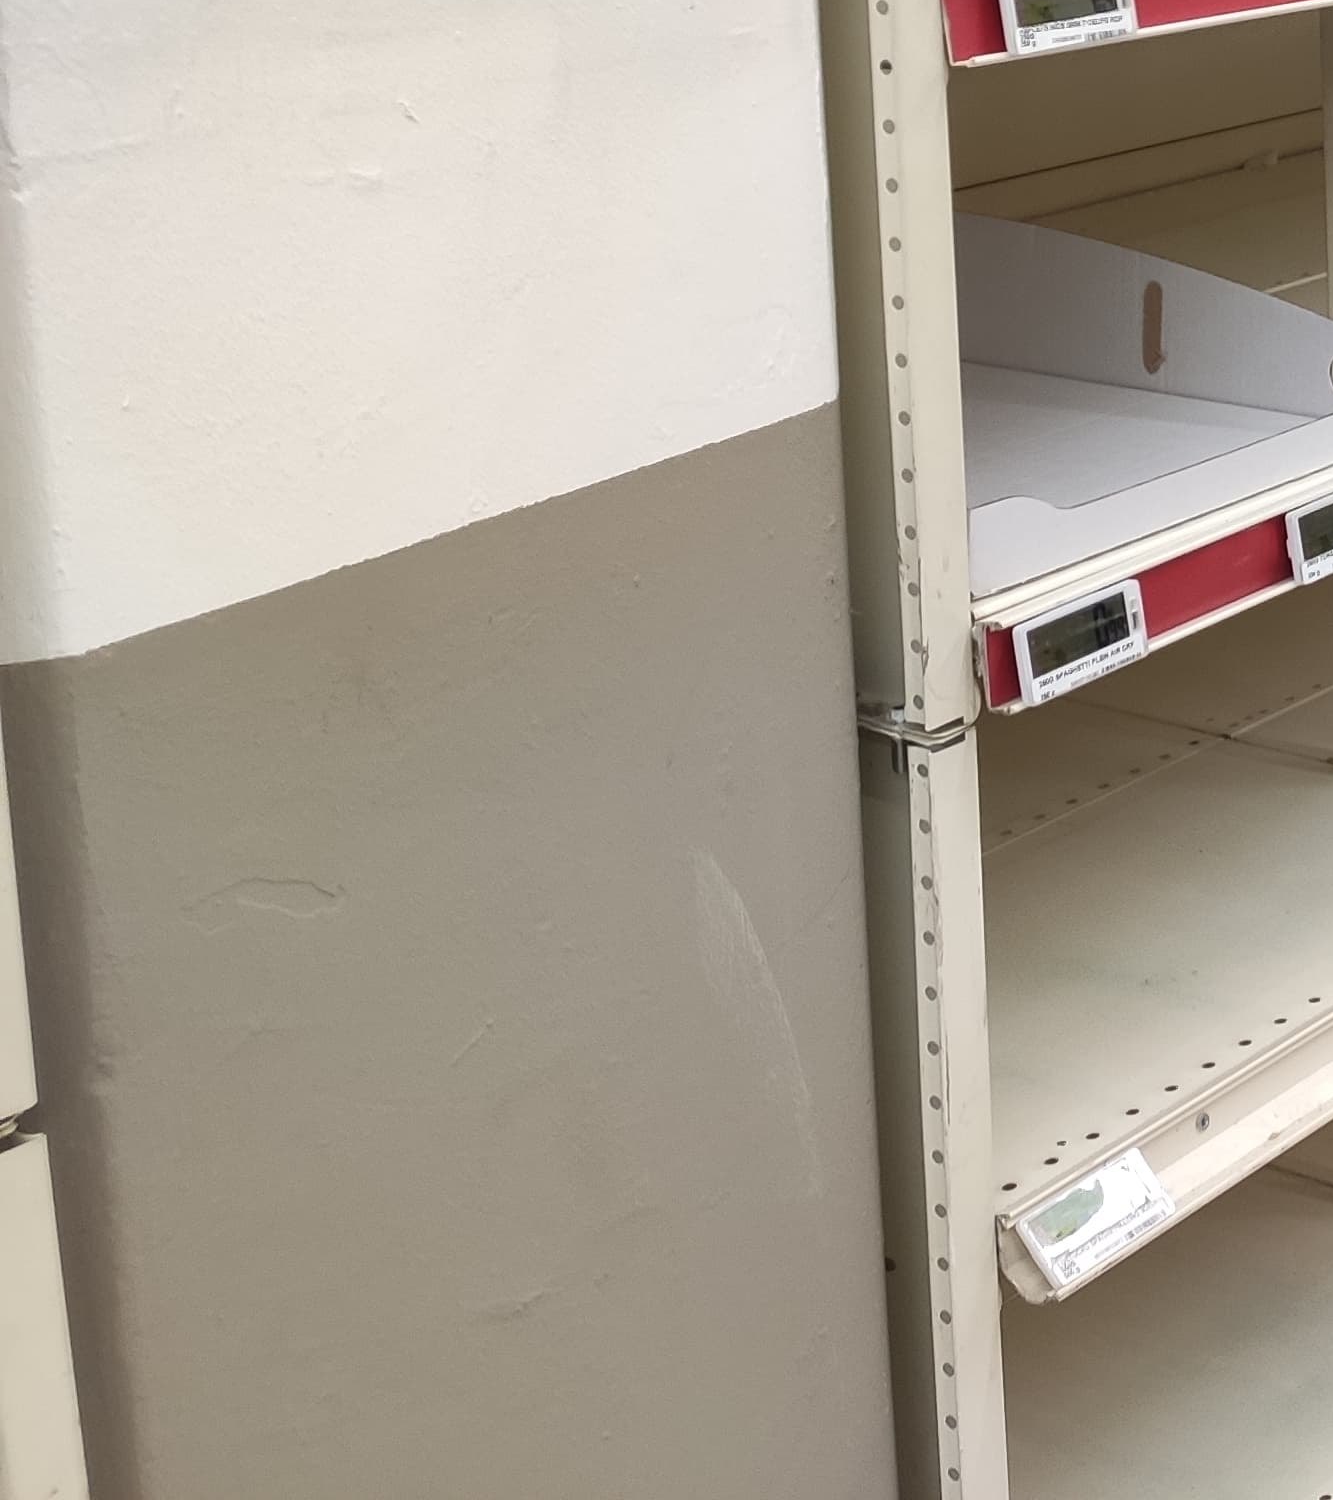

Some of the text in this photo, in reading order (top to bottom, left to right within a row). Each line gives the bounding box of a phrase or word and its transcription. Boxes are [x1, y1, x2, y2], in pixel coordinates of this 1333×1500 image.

[1055, 661, 1091, 681] SPAGHETTI
[1091, 652, 1109, 665] PLEIN
[1110, 646, 1121, 656] AIR
